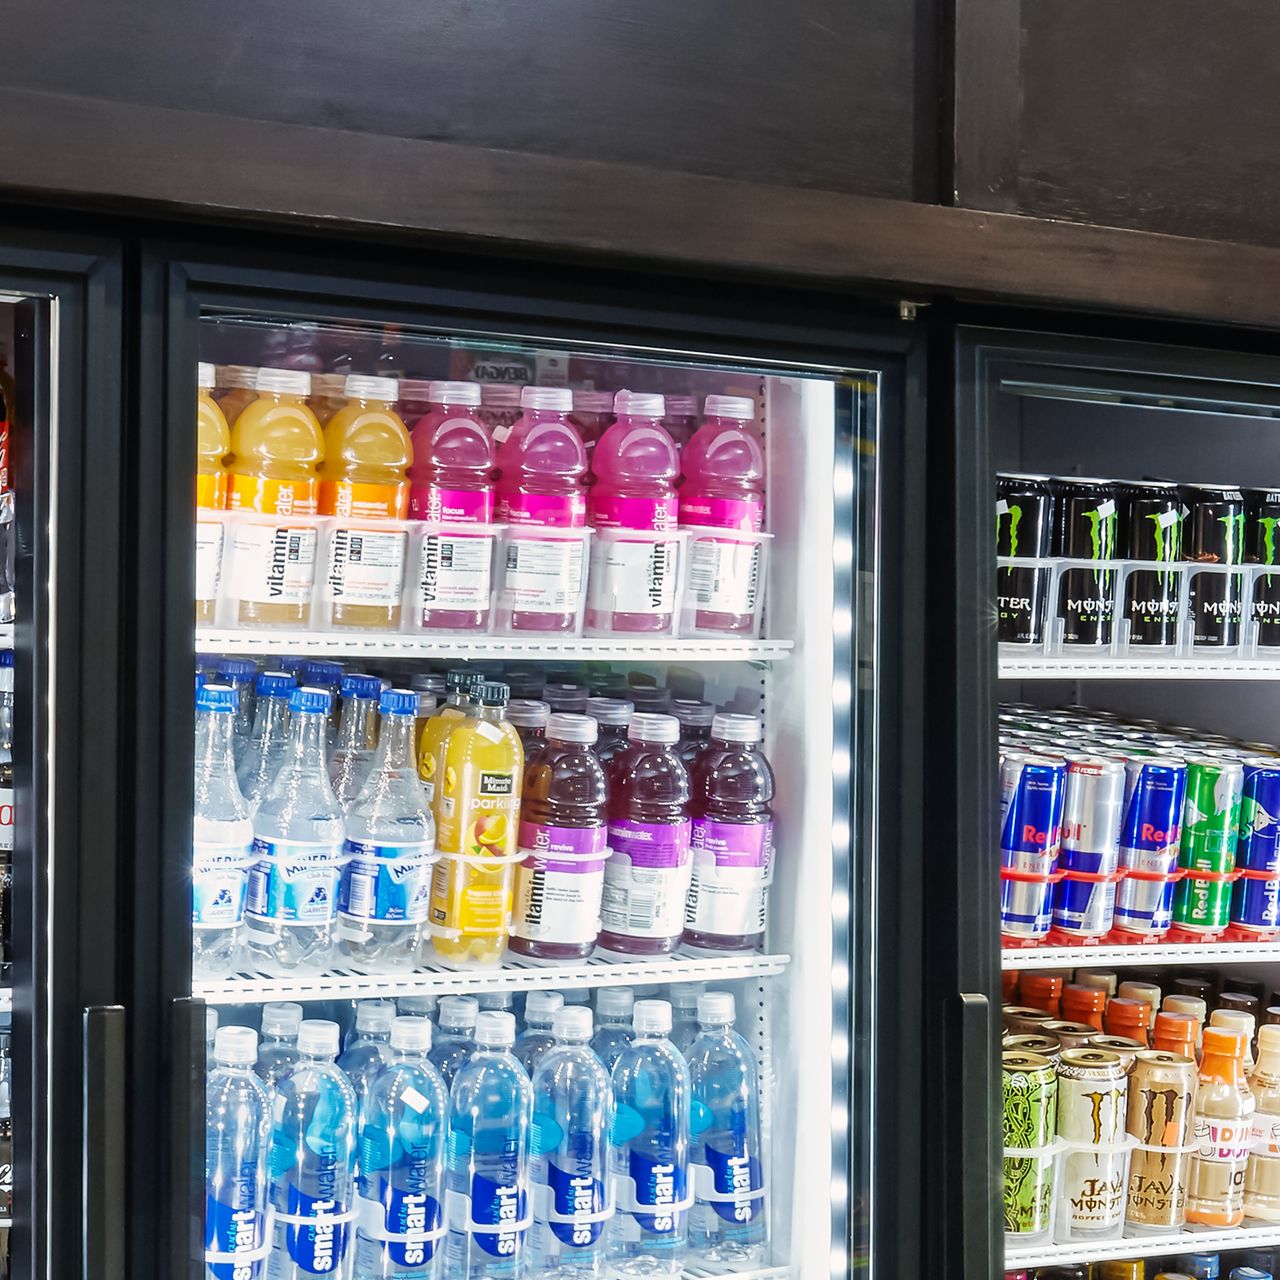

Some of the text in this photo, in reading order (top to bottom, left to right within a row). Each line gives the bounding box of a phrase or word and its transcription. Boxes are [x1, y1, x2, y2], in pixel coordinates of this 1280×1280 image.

[483, 776, 512, 785] Minute
[487, 784, 508, 792] Maid
[1192, 889, 1209, 919] Red
[1130, 1174, 1184, 1196] JAVA
